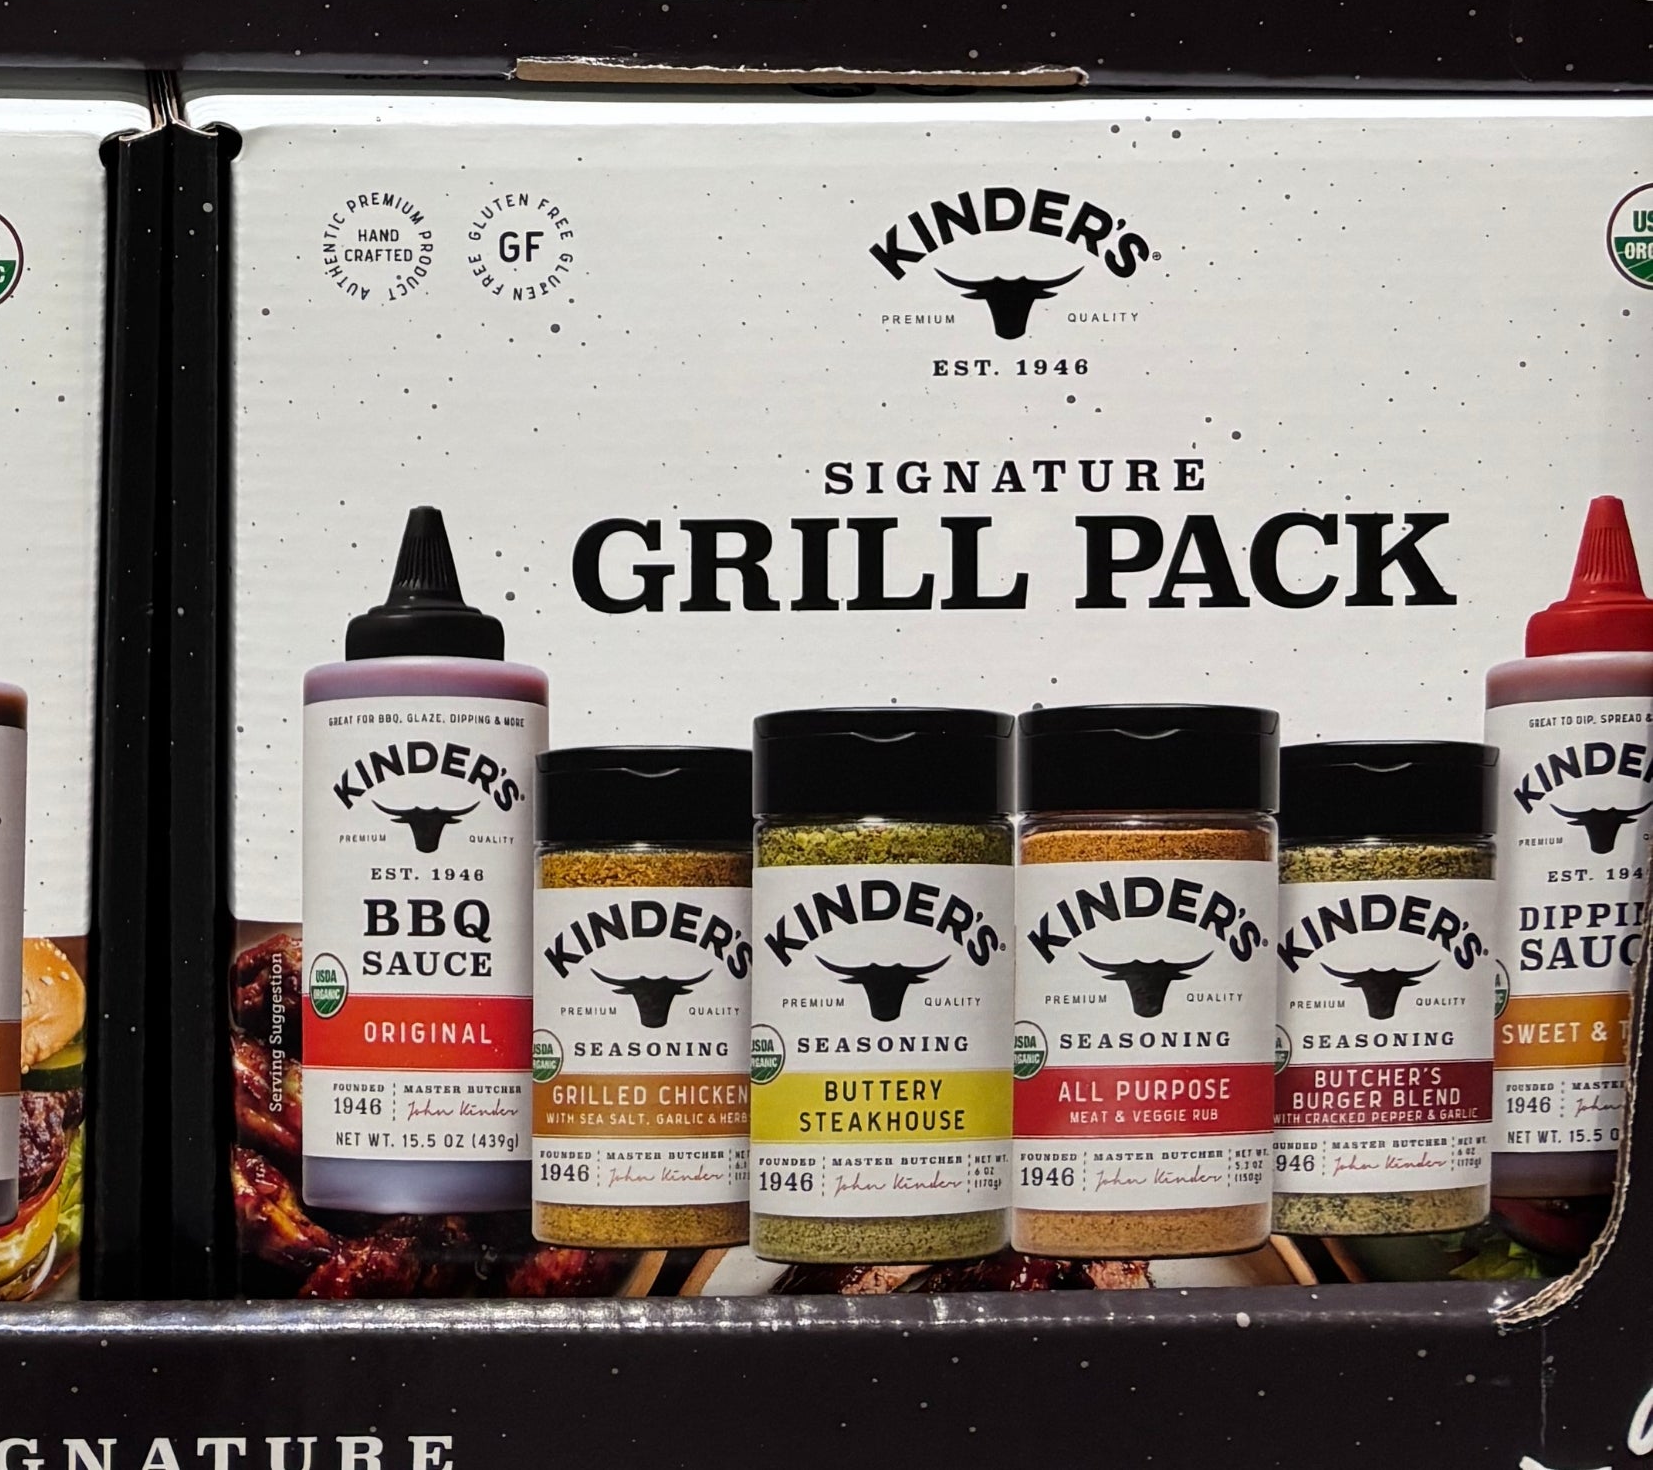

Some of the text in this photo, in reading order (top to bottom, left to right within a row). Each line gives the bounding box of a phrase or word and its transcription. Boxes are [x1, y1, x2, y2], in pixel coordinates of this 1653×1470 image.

[868, 186, 1150, 282] KINDER'S
[932, 359, 1089, 377] EST. 1946
[823, 458, 1209, 498] SIGNATURE
[571, 512, 1459, 614] GRILL PACK
[363, 898, 492, 943] BBQ
[362, 951, 492, 977] SAUCE
[364, 1021, 492, 1044] ORIGINAL
[825, 1079, 943, 1102] BUTTERY
[1058, 1078, 1231, 1103] ALL PURPOSE
[799, 1109, 966, 1132] STEAKHOUSE
